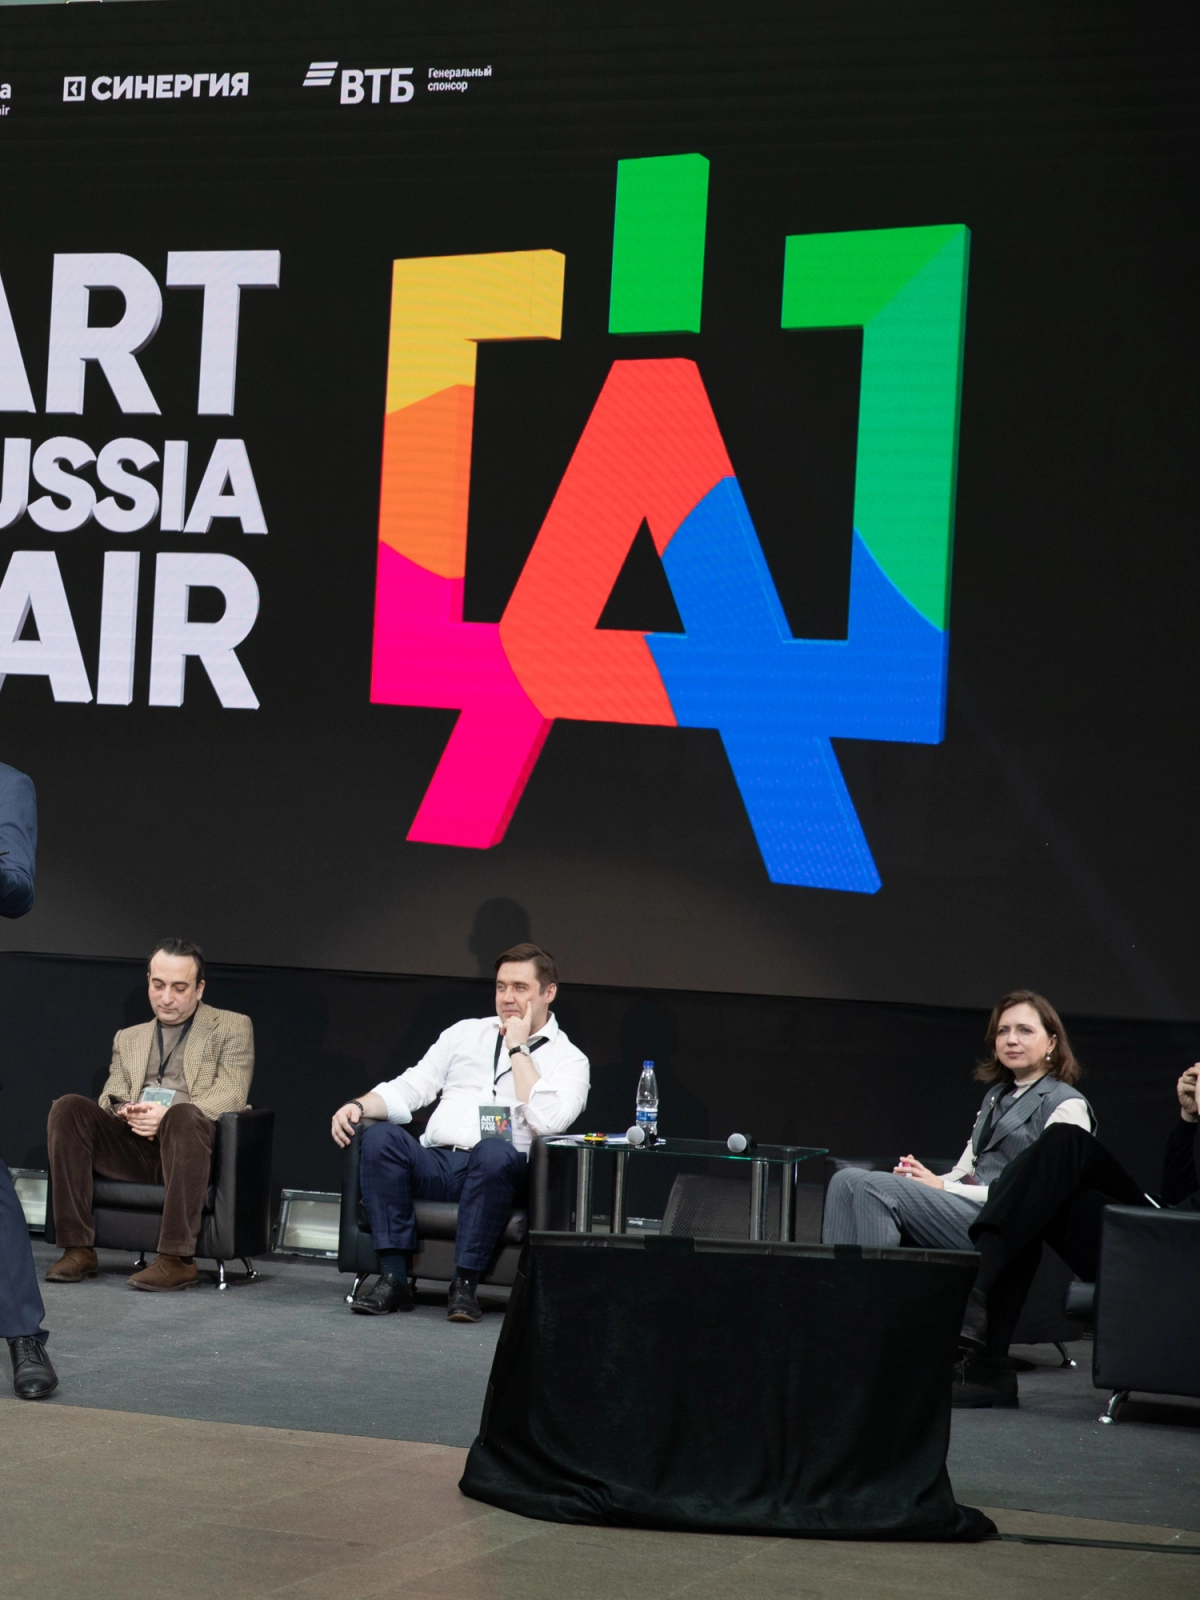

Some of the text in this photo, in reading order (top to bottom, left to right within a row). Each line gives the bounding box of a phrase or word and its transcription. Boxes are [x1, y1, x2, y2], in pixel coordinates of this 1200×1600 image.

[428, 65, 493, 80] Генеральный
[92, 72, 249, 100] СИНЕРГИЯ
[340, 67, 415, 104] ВТБ
[427, 81, 469, 93] спонсор
